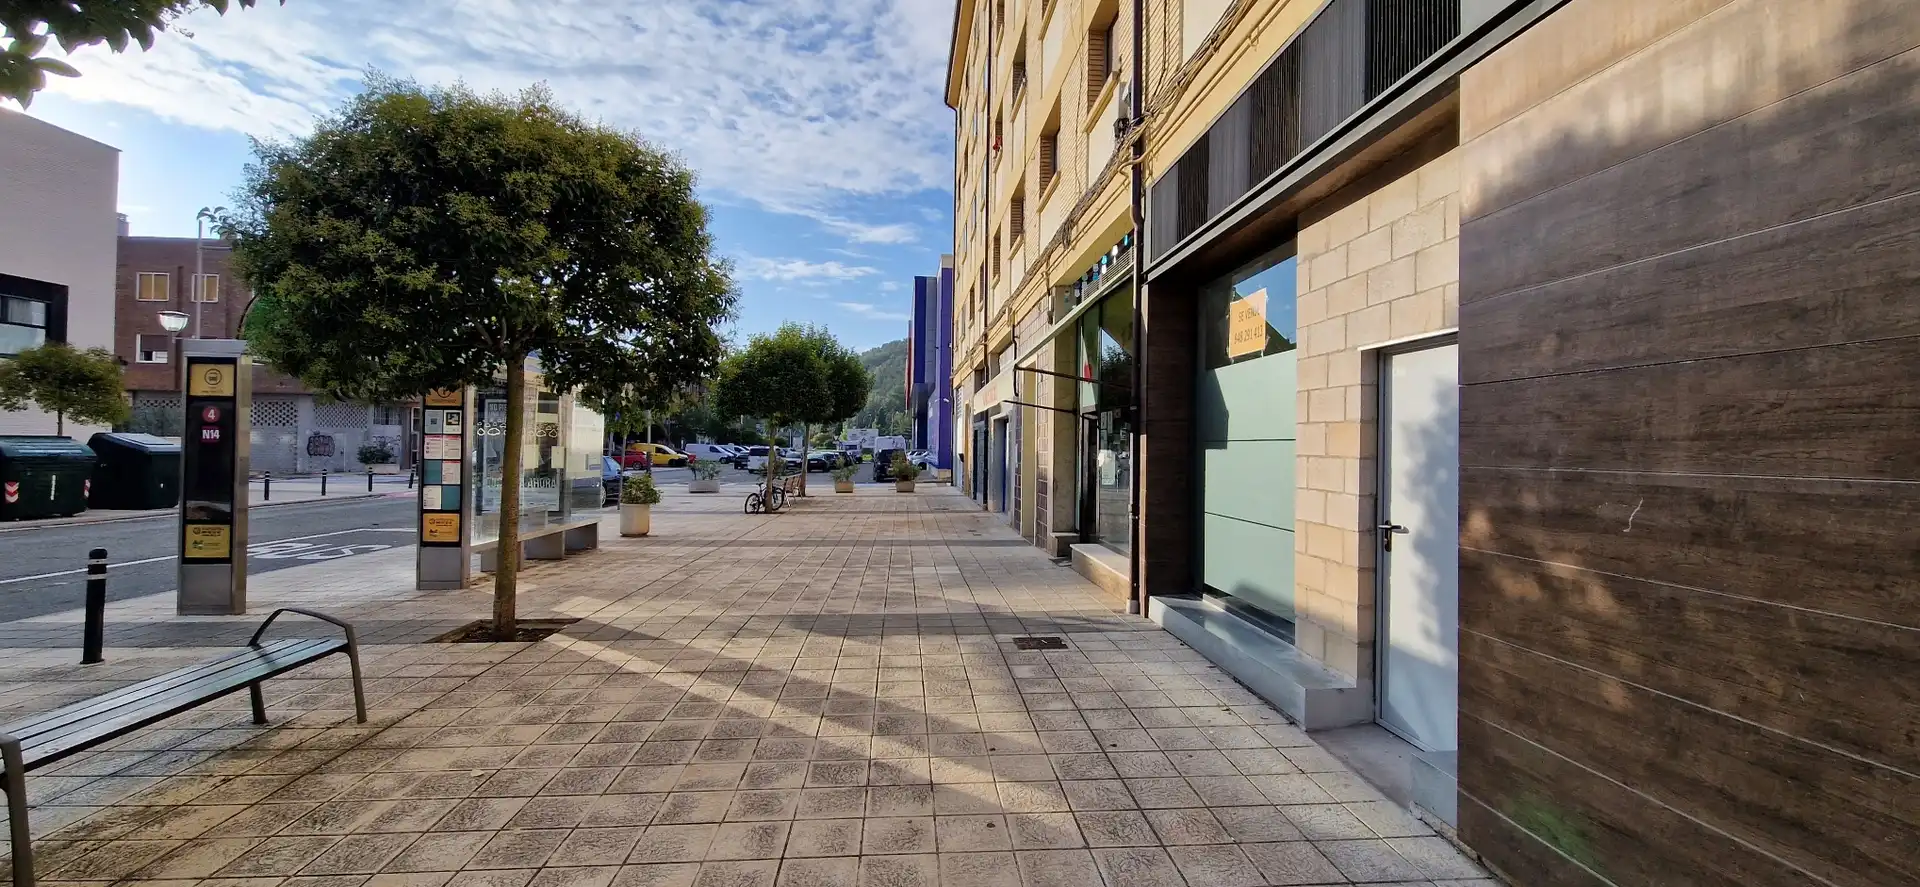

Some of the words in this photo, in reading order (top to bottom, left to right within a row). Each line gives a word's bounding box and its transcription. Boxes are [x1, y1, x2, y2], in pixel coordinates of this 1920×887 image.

[1238, 310, 1245, 323] SE
[1245, 304, 1261, 320] VEN
[207, 409, 216, 420] 4
[202, 429, 220, 440] N14
[527, 477, 556, 489] AHORA
